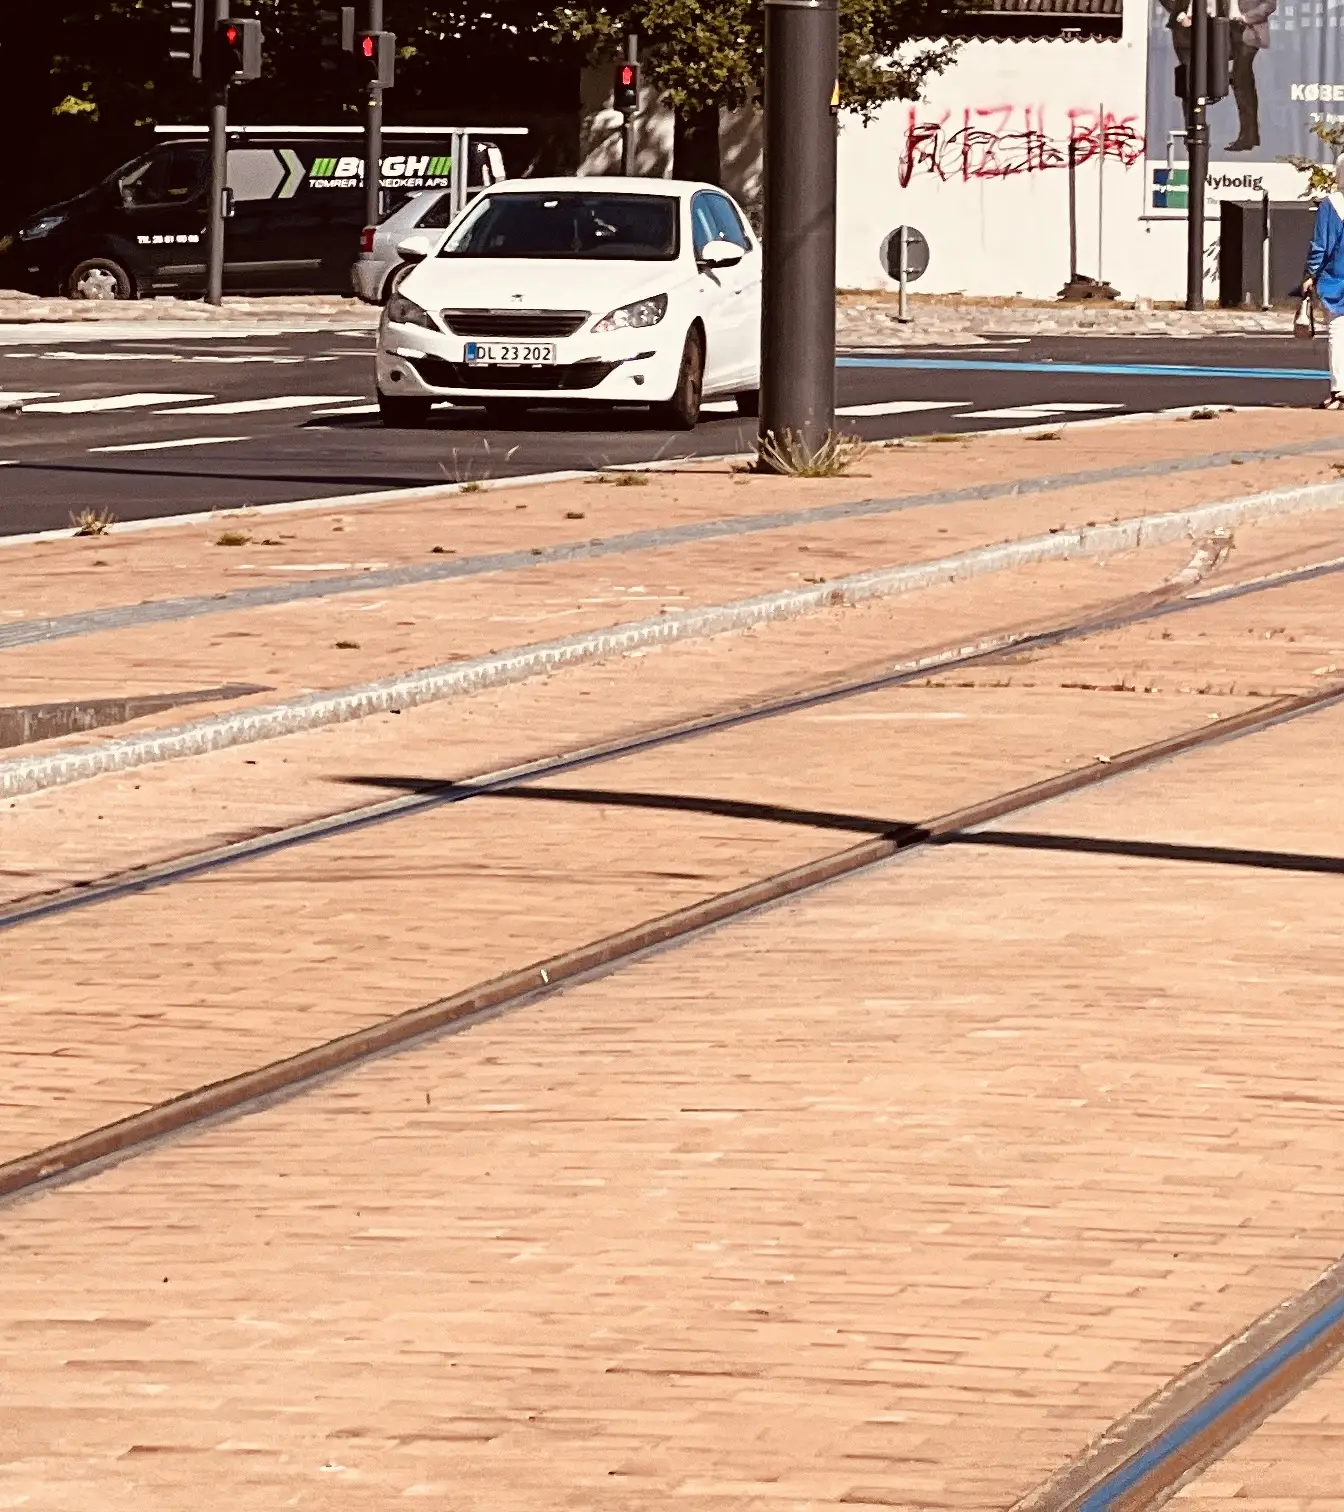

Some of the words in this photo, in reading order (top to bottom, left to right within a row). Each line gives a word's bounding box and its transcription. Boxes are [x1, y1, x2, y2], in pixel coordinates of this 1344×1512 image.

[424, 178, 448, 187] APS
[1206, 173, 1263, 191] Nybolig
[476, 346, 496, 360] DL
[501, 346, 519, 361] 23
[523, 346, 551, 361] 202
